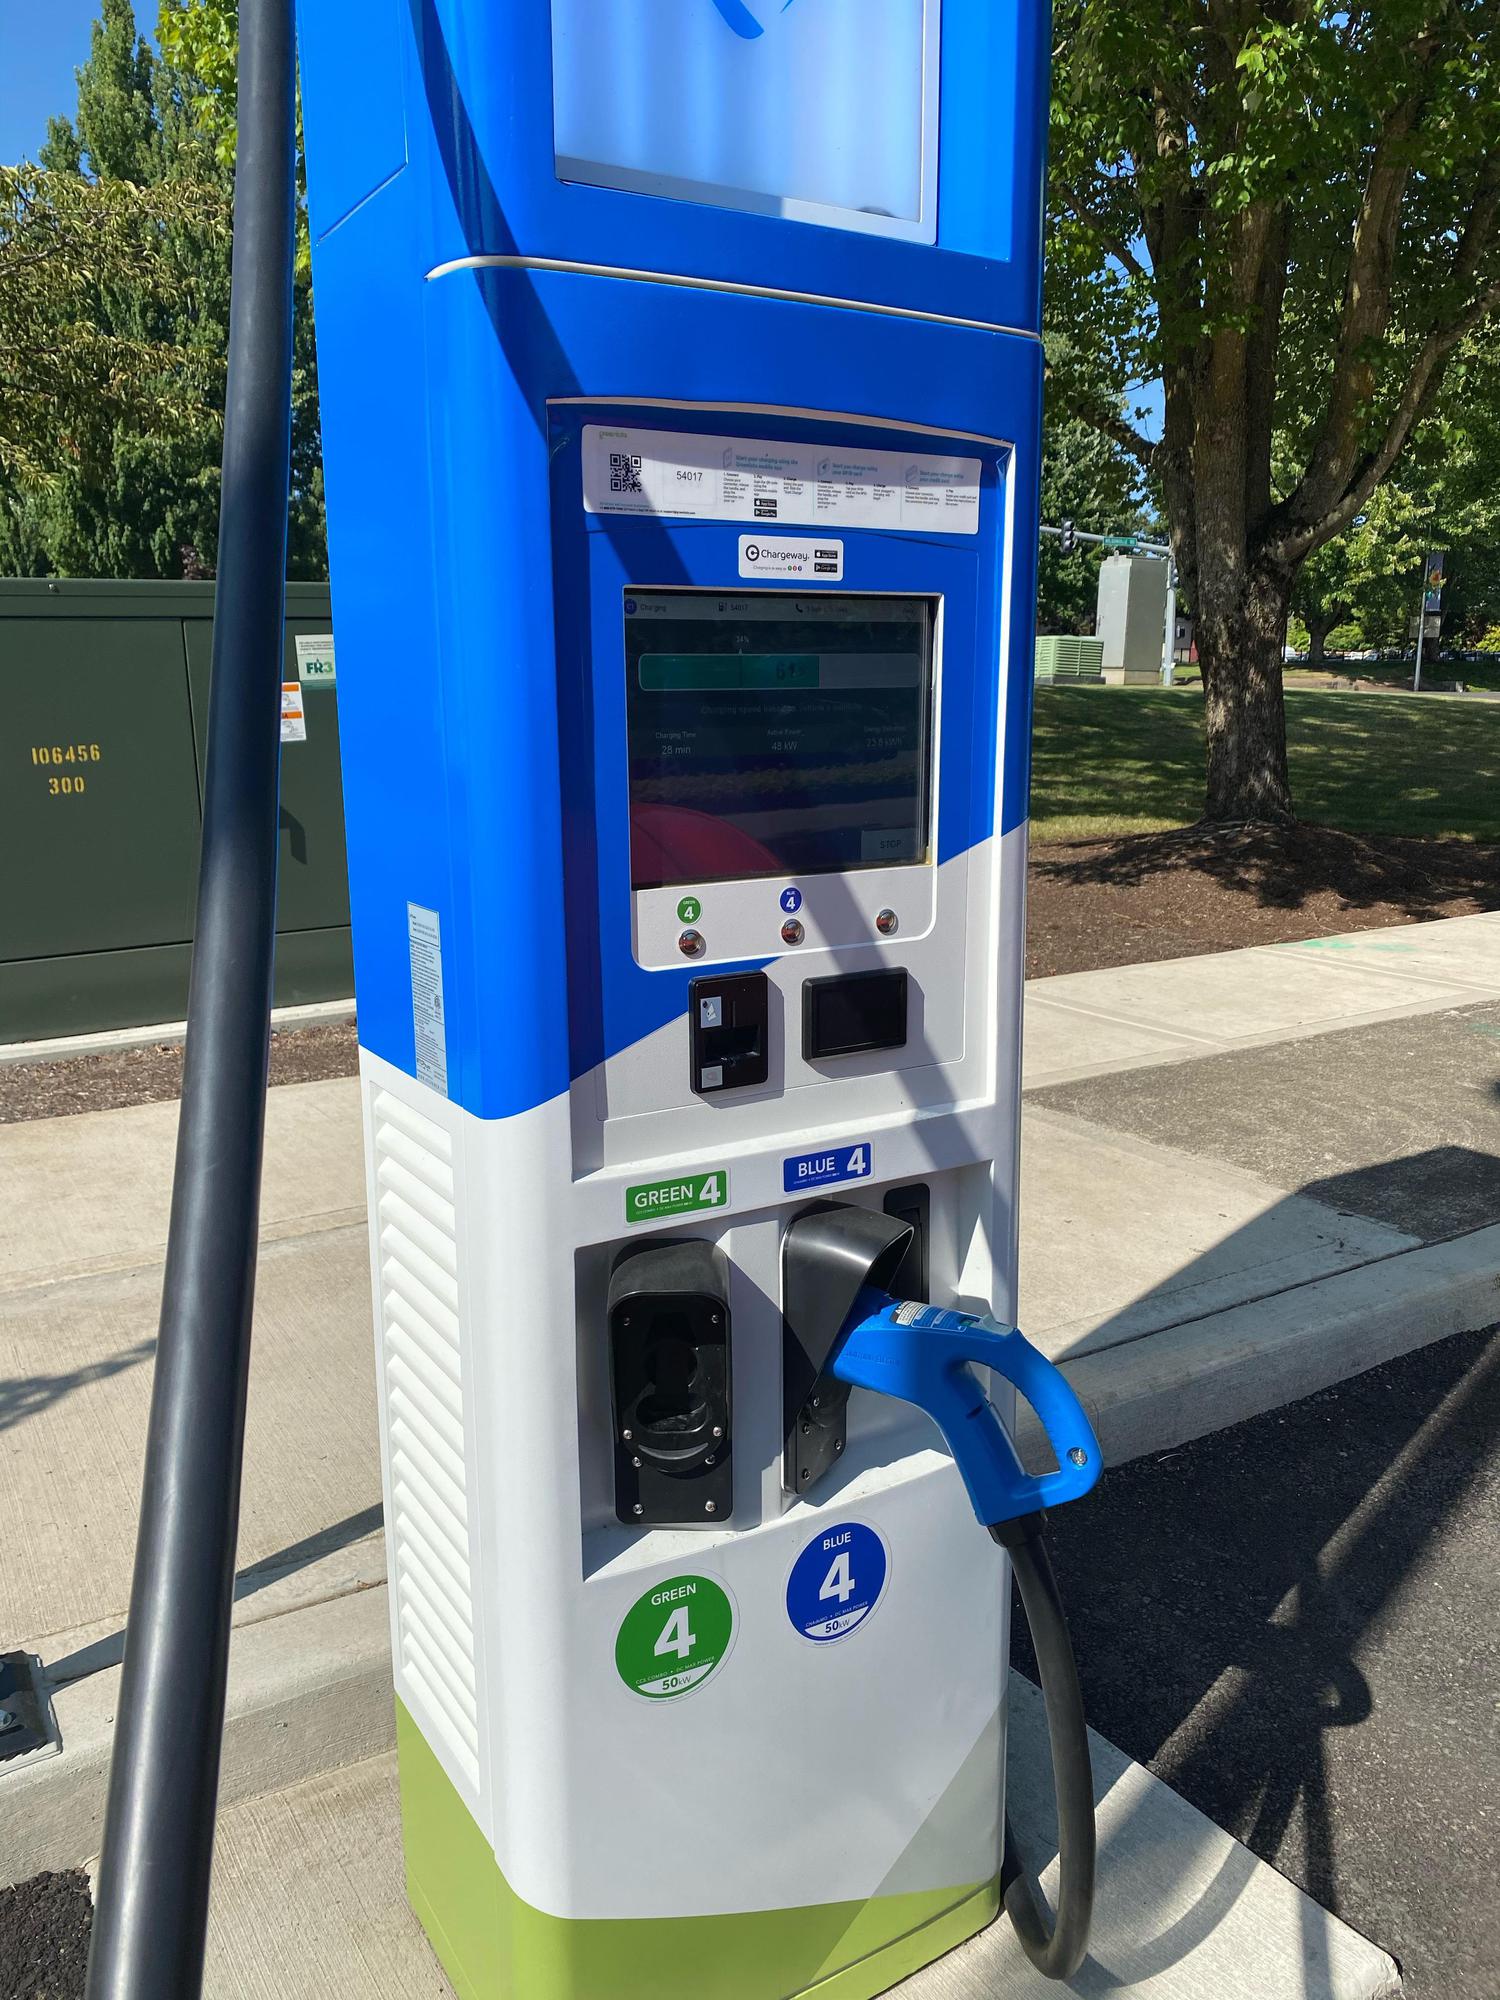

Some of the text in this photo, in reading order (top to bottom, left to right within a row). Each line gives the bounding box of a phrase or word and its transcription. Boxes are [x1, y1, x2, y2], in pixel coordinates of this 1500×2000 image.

[676, 470, 703, 482] 54017
[306, 661, 333, 674] FR3
[661, 745, 691, 755] 28 min
[48, 777, 85, 795] 300
[880, 840, 902, 849] STOP
[786, 896, 795, 909] 4
[684, 906, 694, 919] 4
[798, 1147, 866, 1177] BLUE 4
[634, 1175, 720, 1208] GREEN 4
[822, 1531, 851, 1551] BLUE
[819, 1551, 855, 1603] 4
[651, 1583, 697, 1606] GREEN
[653, 1605, 696, 1659] 4
